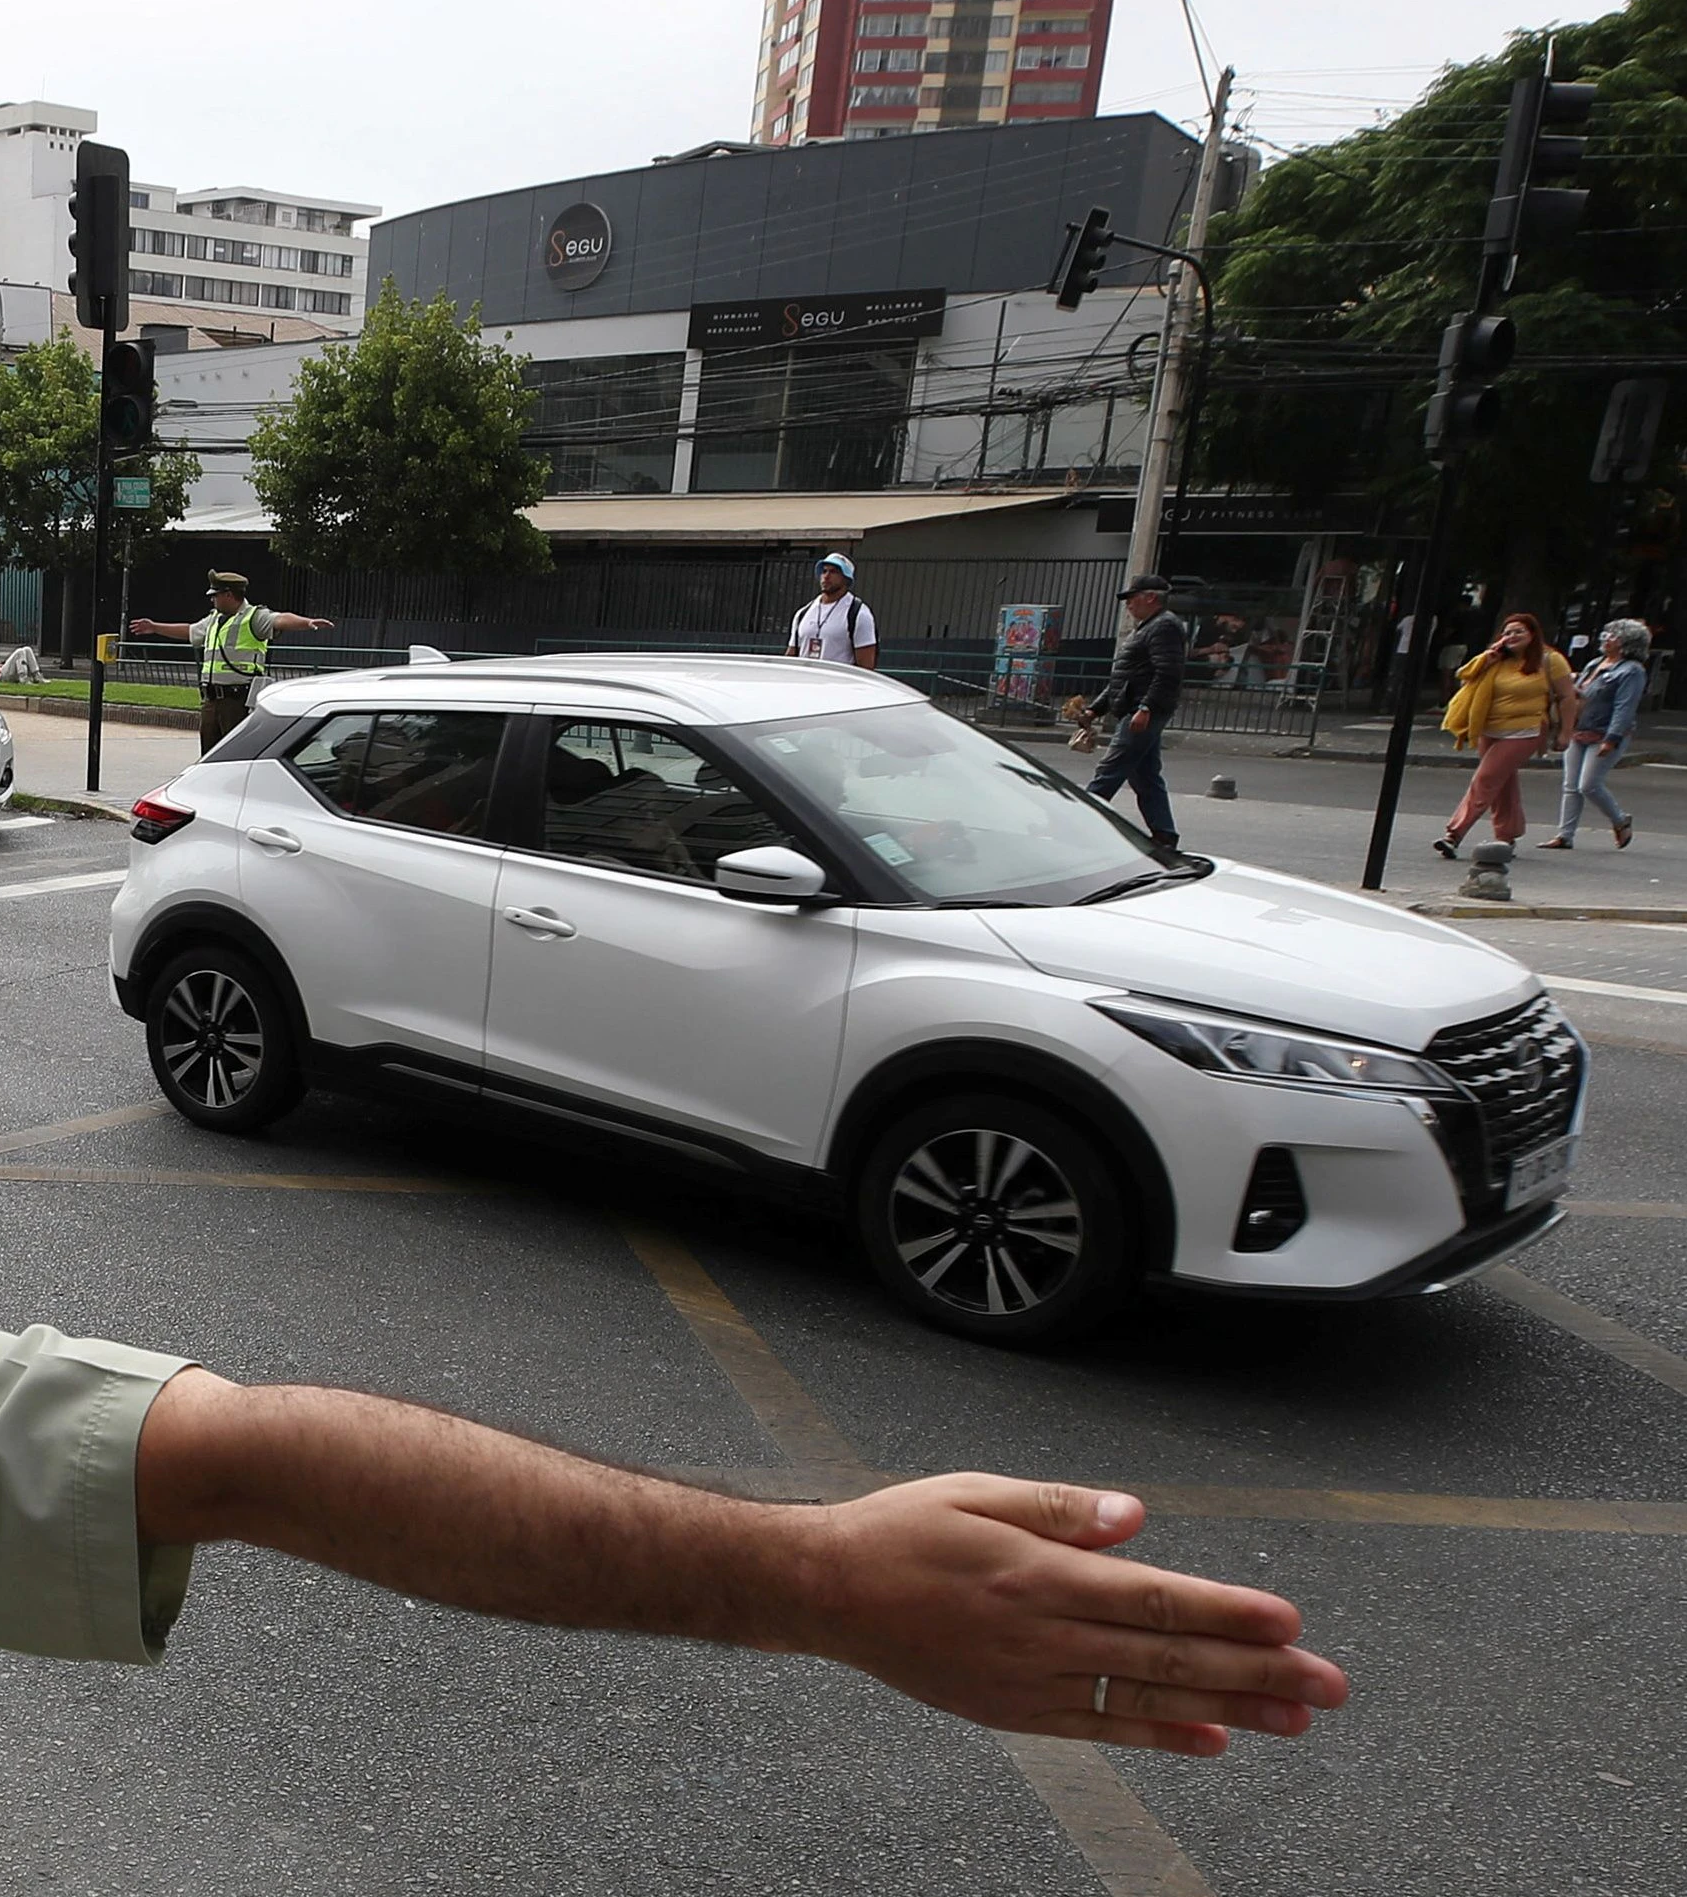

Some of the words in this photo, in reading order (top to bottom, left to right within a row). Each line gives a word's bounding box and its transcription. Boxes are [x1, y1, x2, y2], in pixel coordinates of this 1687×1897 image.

[866, 301, 923, 312] WELLNESS
[712, 312, 760, 321] GIMNASIO
[706, 325, 763, 335] RESTAURANT
[1211, 510, 1275, 519] FITNESS
